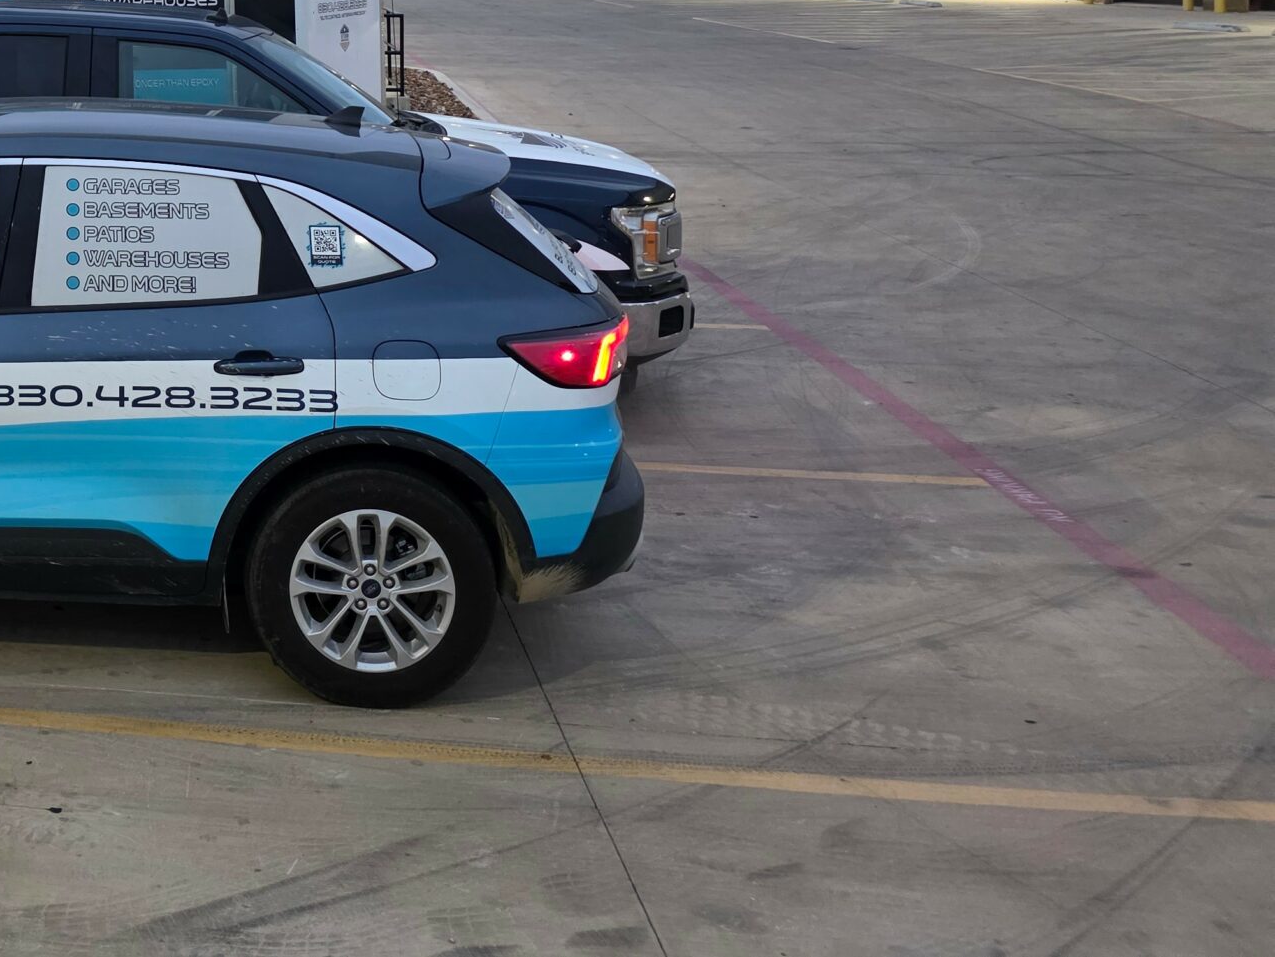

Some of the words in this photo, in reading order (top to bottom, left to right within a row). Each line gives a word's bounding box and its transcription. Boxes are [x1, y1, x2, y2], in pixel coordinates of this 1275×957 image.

[166, 78, 189, 87] THAN
[190, 77, 220, 86] EPOXY
[83, 177, 181, 195] GARAGES
[83, 201, 210, 220] BASEMENTS
[83, 225, 155, 243] PATIOS
[83, 249, 231, 270] WAREHOUSES
[83, 274, 129, 292] AND
[131, 275, 197, 293] MORE!
